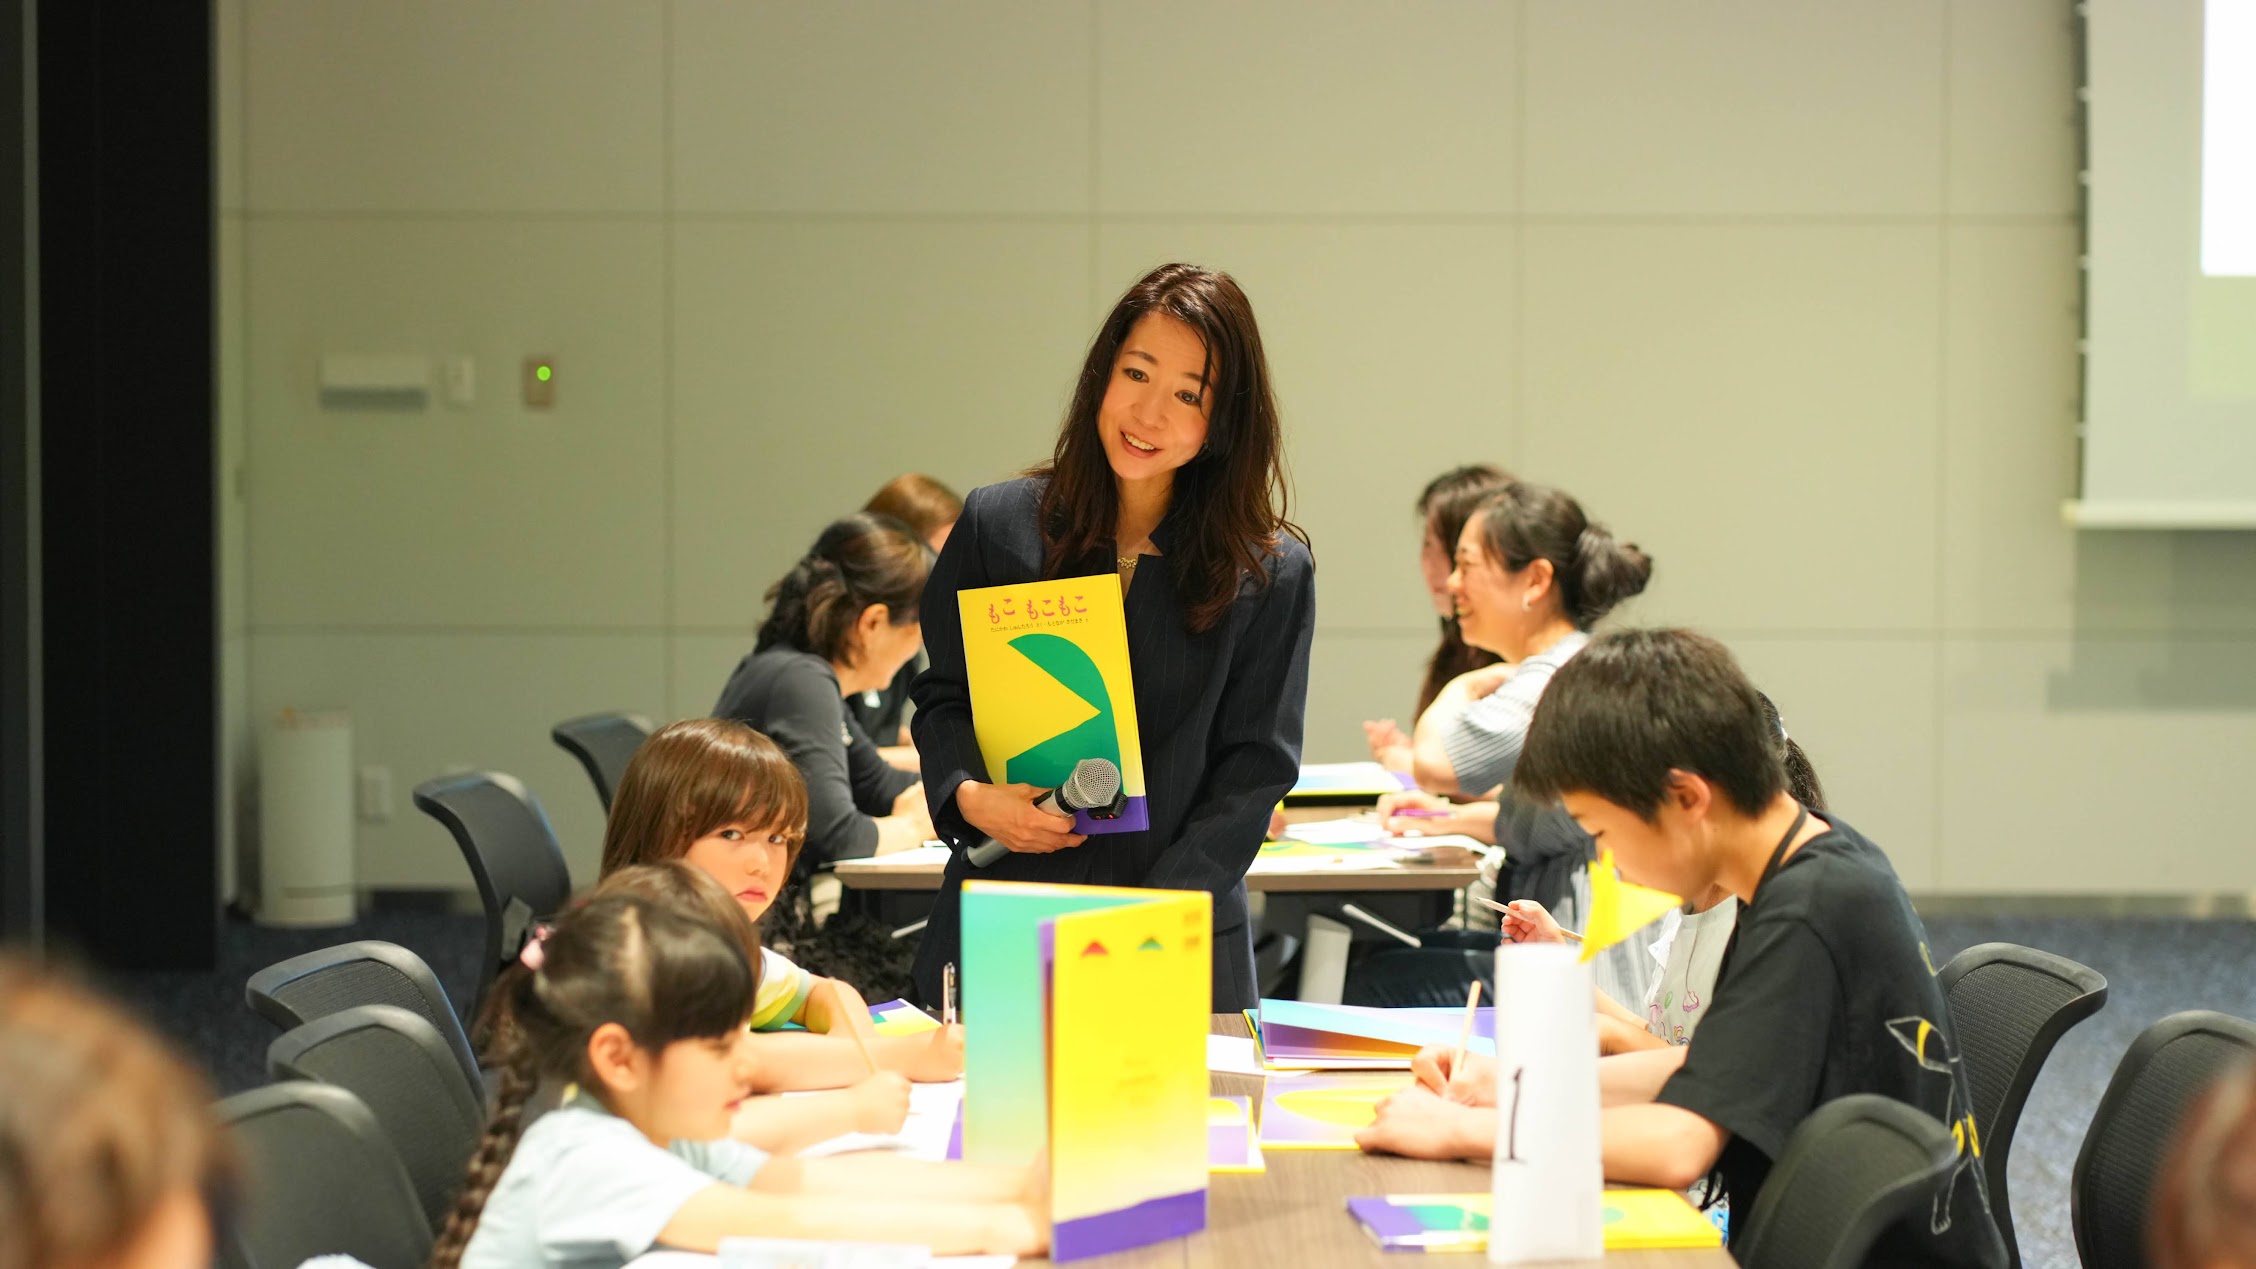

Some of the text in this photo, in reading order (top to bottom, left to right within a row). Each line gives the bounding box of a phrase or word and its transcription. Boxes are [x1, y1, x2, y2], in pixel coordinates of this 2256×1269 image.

[988, 596, 1087, 624] もこ もこもこ
[1502, 1066, 1526, 1163] 1
